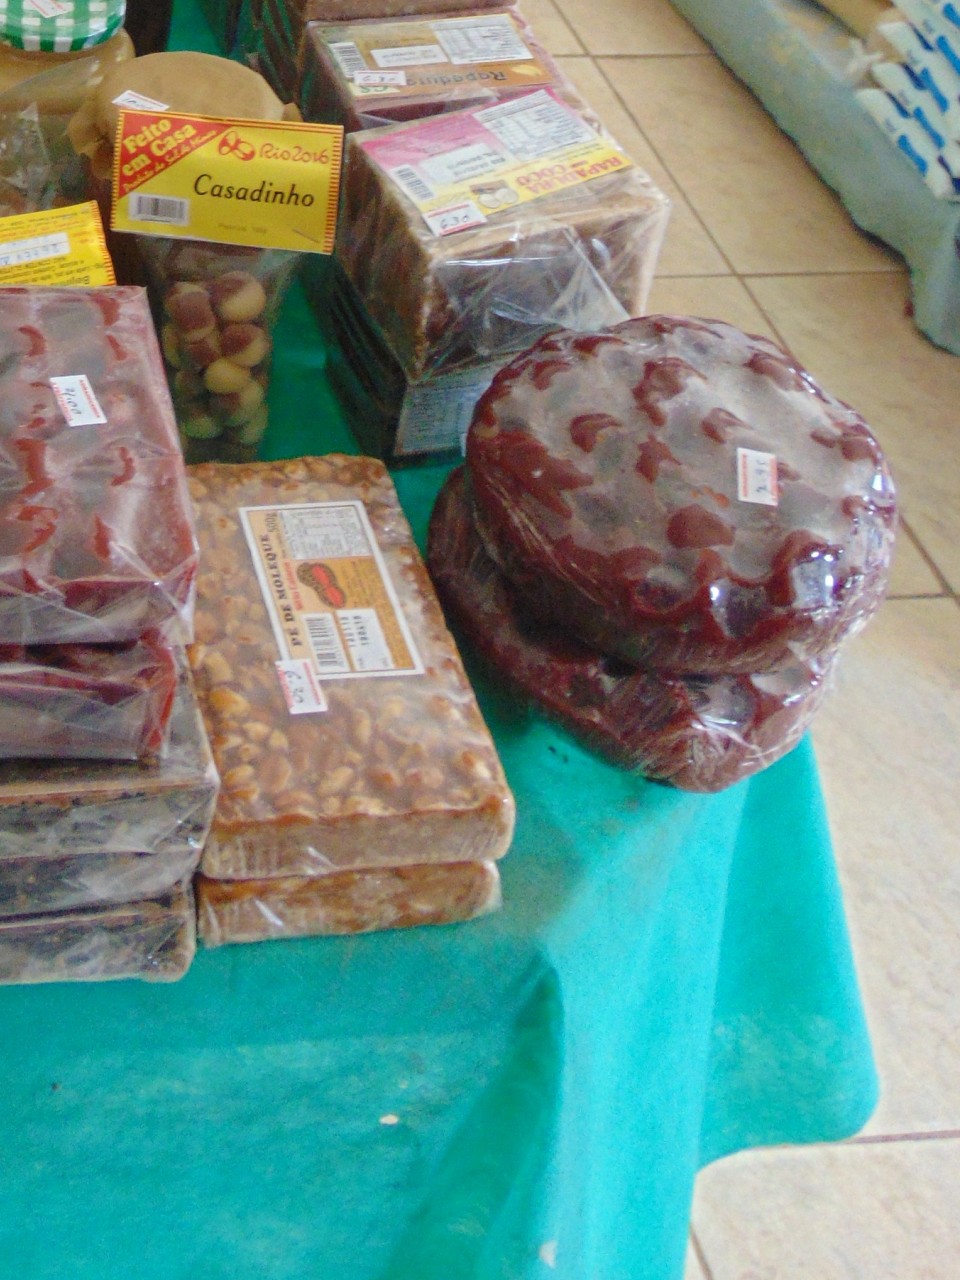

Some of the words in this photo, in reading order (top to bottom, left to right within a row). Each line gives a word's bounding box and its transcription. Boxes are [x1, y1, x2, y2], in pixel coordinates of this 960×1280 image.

[121, 118, 172, 154] Feito
[122, 153, 151, 176] em
[149, 123, 197, 157] Casa
[193, 174, 316, 208] Casadinho
[260, 534, 289, 601] MOLEQUE
[280, 604, 295, 623] DE
